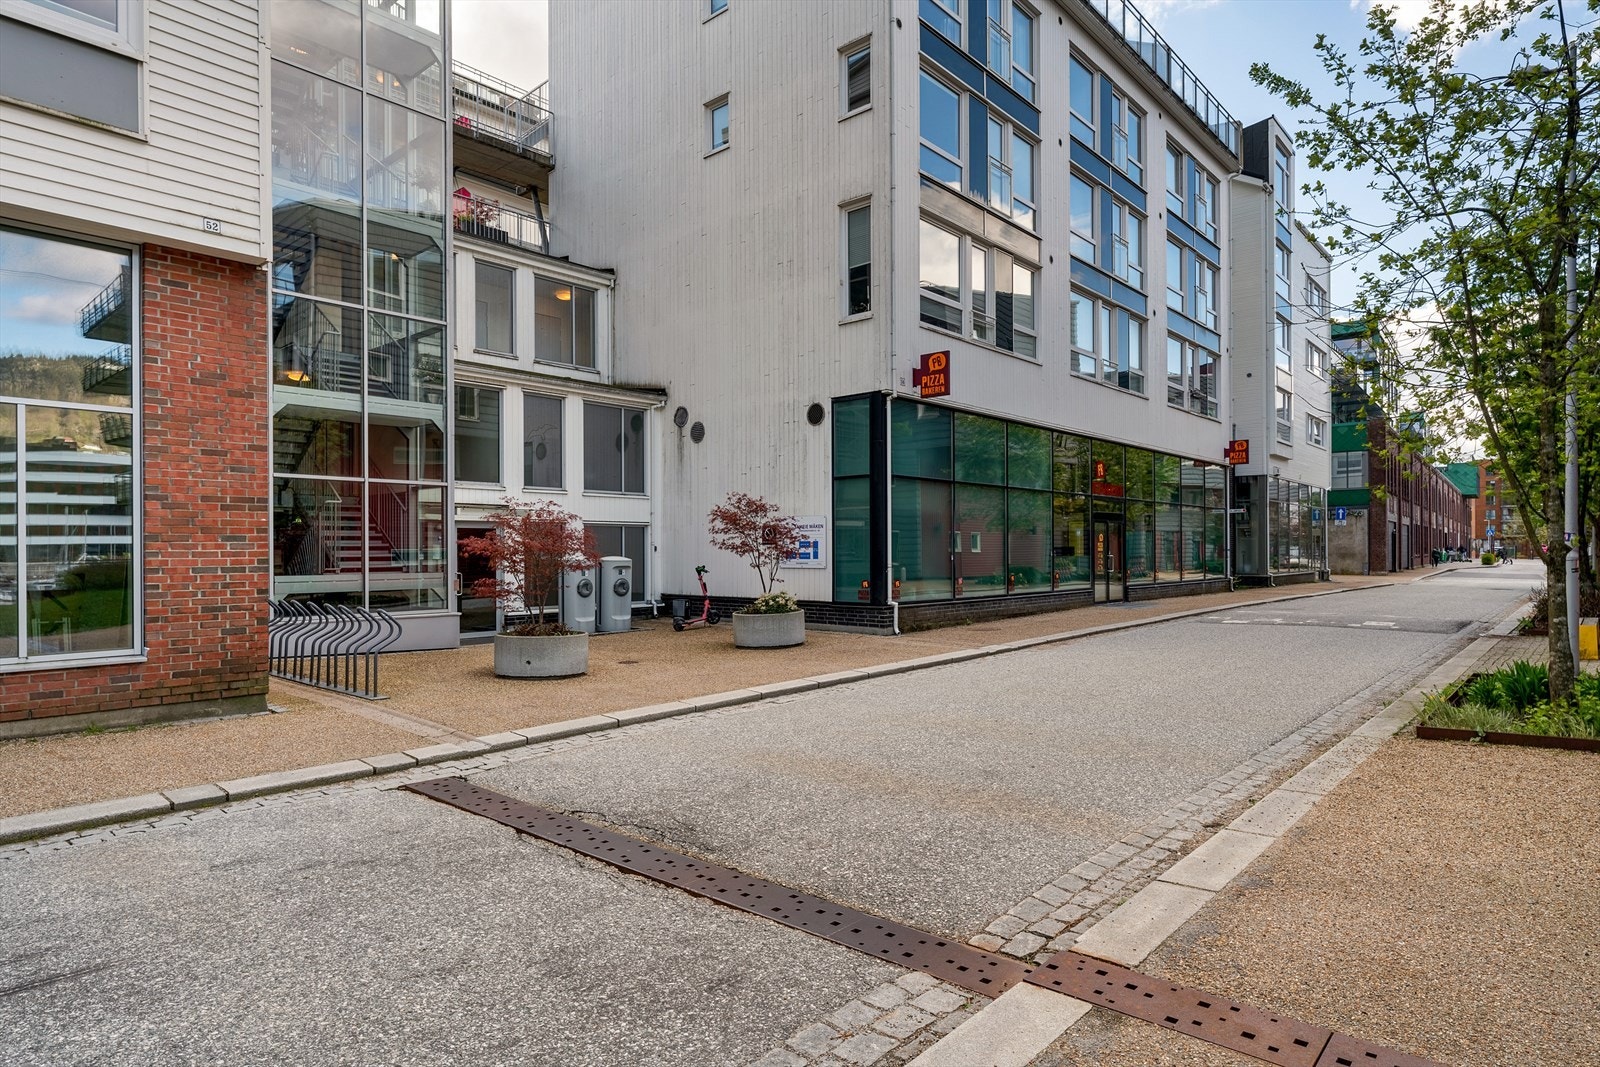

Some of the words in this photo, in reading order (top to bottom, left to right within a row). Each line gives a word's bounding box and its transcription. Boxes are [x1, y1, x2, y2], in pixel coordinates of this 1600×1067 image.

[206, 220, 219, 232] 52
[932, 355, 942, 369] PB
[921, 373, 945, 388] PIZZA
[921, 385, 945, 396] BAKEREN
[1229, 451, 1247, 460] PIZZA
